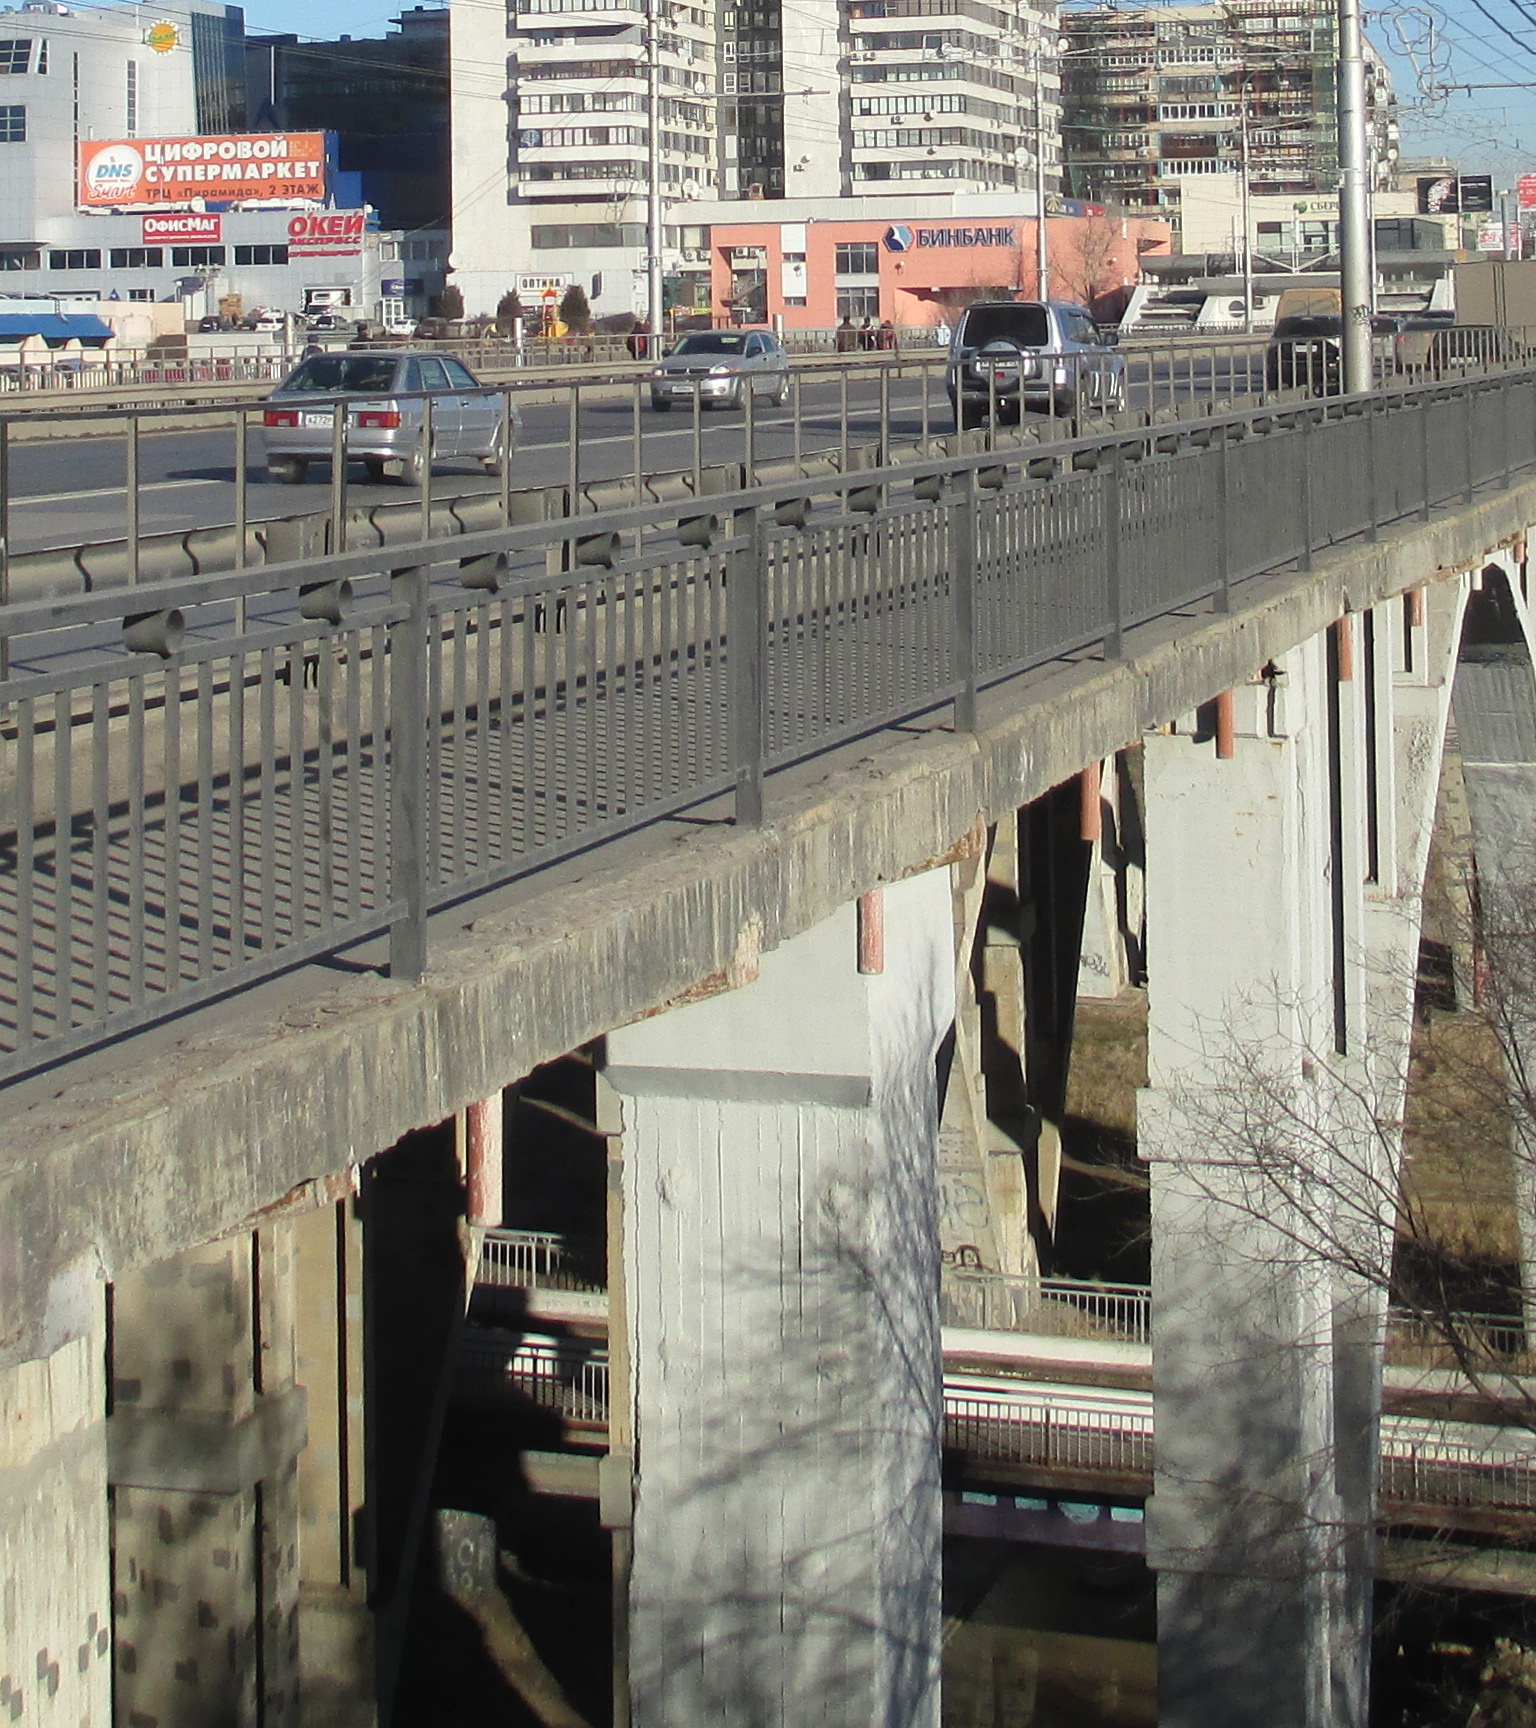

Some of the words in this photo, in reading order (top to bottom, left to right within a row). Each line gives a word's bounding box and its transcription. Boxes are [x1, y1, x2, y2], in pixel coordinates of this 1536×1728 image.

[144, 136, 288, 164] ЦИФРОВОЙ
[96, 163, 134, 179] DNS
[145, 161, 321, 183] СУПЕРМАРКЕТ
[88, 183, 137, 201] Smart
[145, 188, 172, 200] ТРЦ
[268, 184, 277, 195] 2
[282, 183, 320, 196] ЭТАЖ
[917, 227, 1016, 248] БИНБАНК
